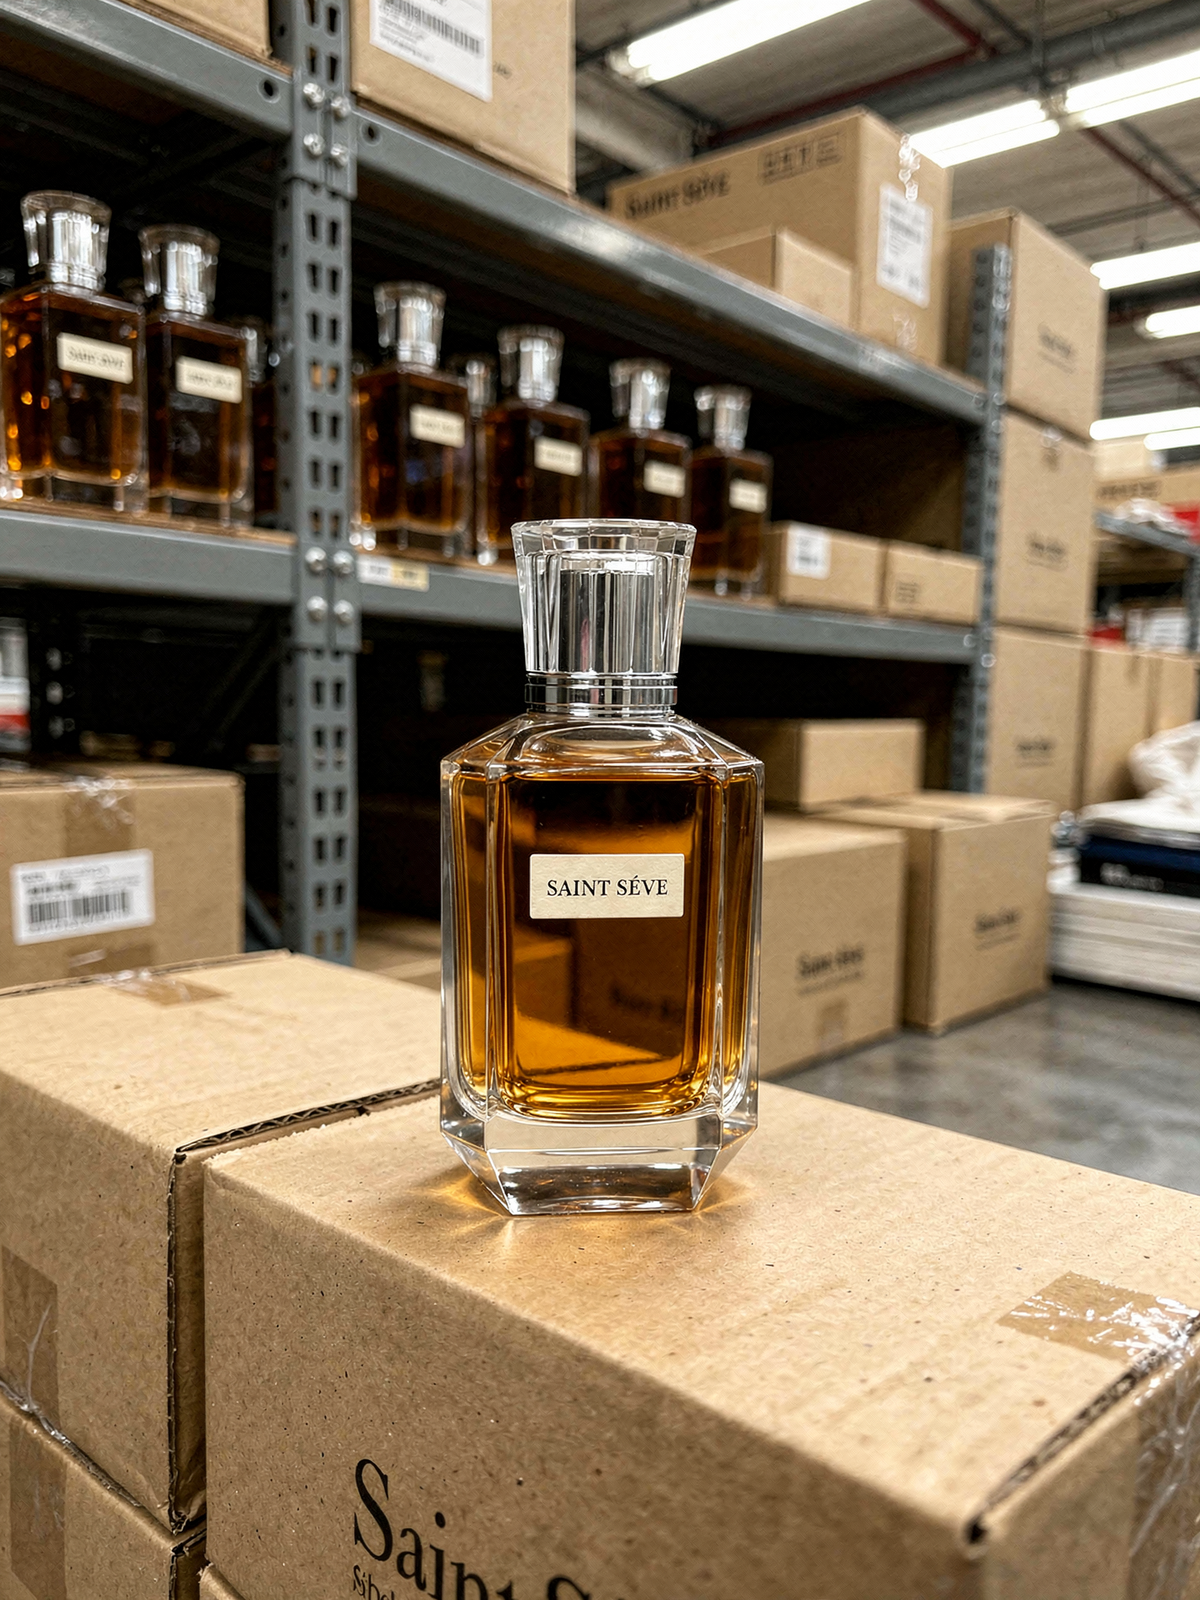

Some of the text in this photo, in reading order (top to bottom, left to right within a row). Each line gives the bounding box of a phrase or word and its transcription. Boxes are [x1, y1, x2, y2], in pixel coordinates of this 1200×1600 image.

[547, 875, 668, 897] SAINT SÉVE
[354, 1458, 517, 1600] Sain
